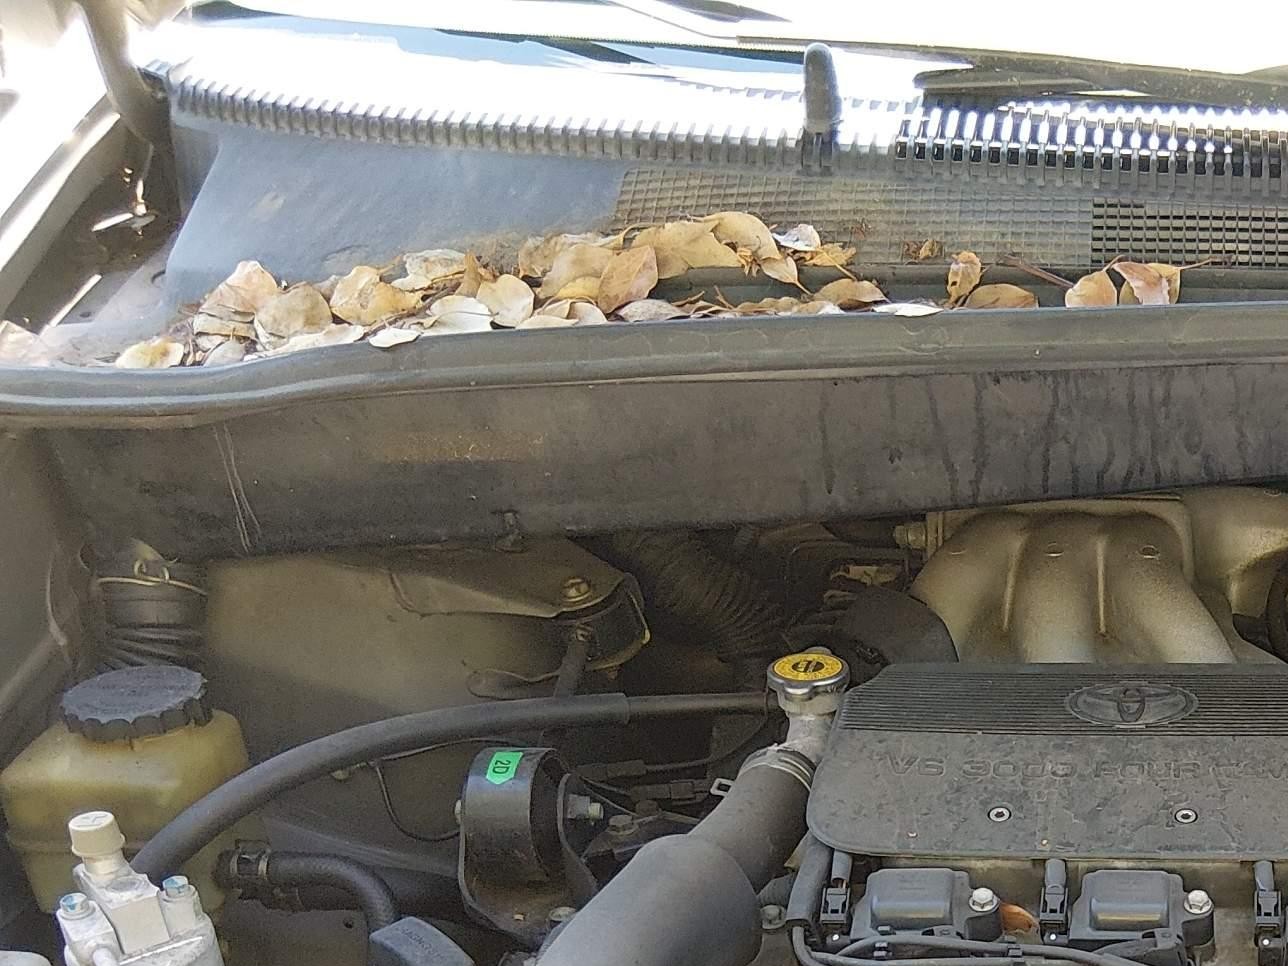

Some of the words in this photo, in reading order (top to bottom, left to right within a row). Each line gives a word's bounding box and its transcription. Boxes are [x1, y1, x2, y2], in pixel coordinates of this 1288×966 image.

[492, 760, 511, 774] 2D
[883, 751, 945, 777] V6
[961, 757, 1077, 779] 3000
[1094, 760, 1202, 780] FOUR
